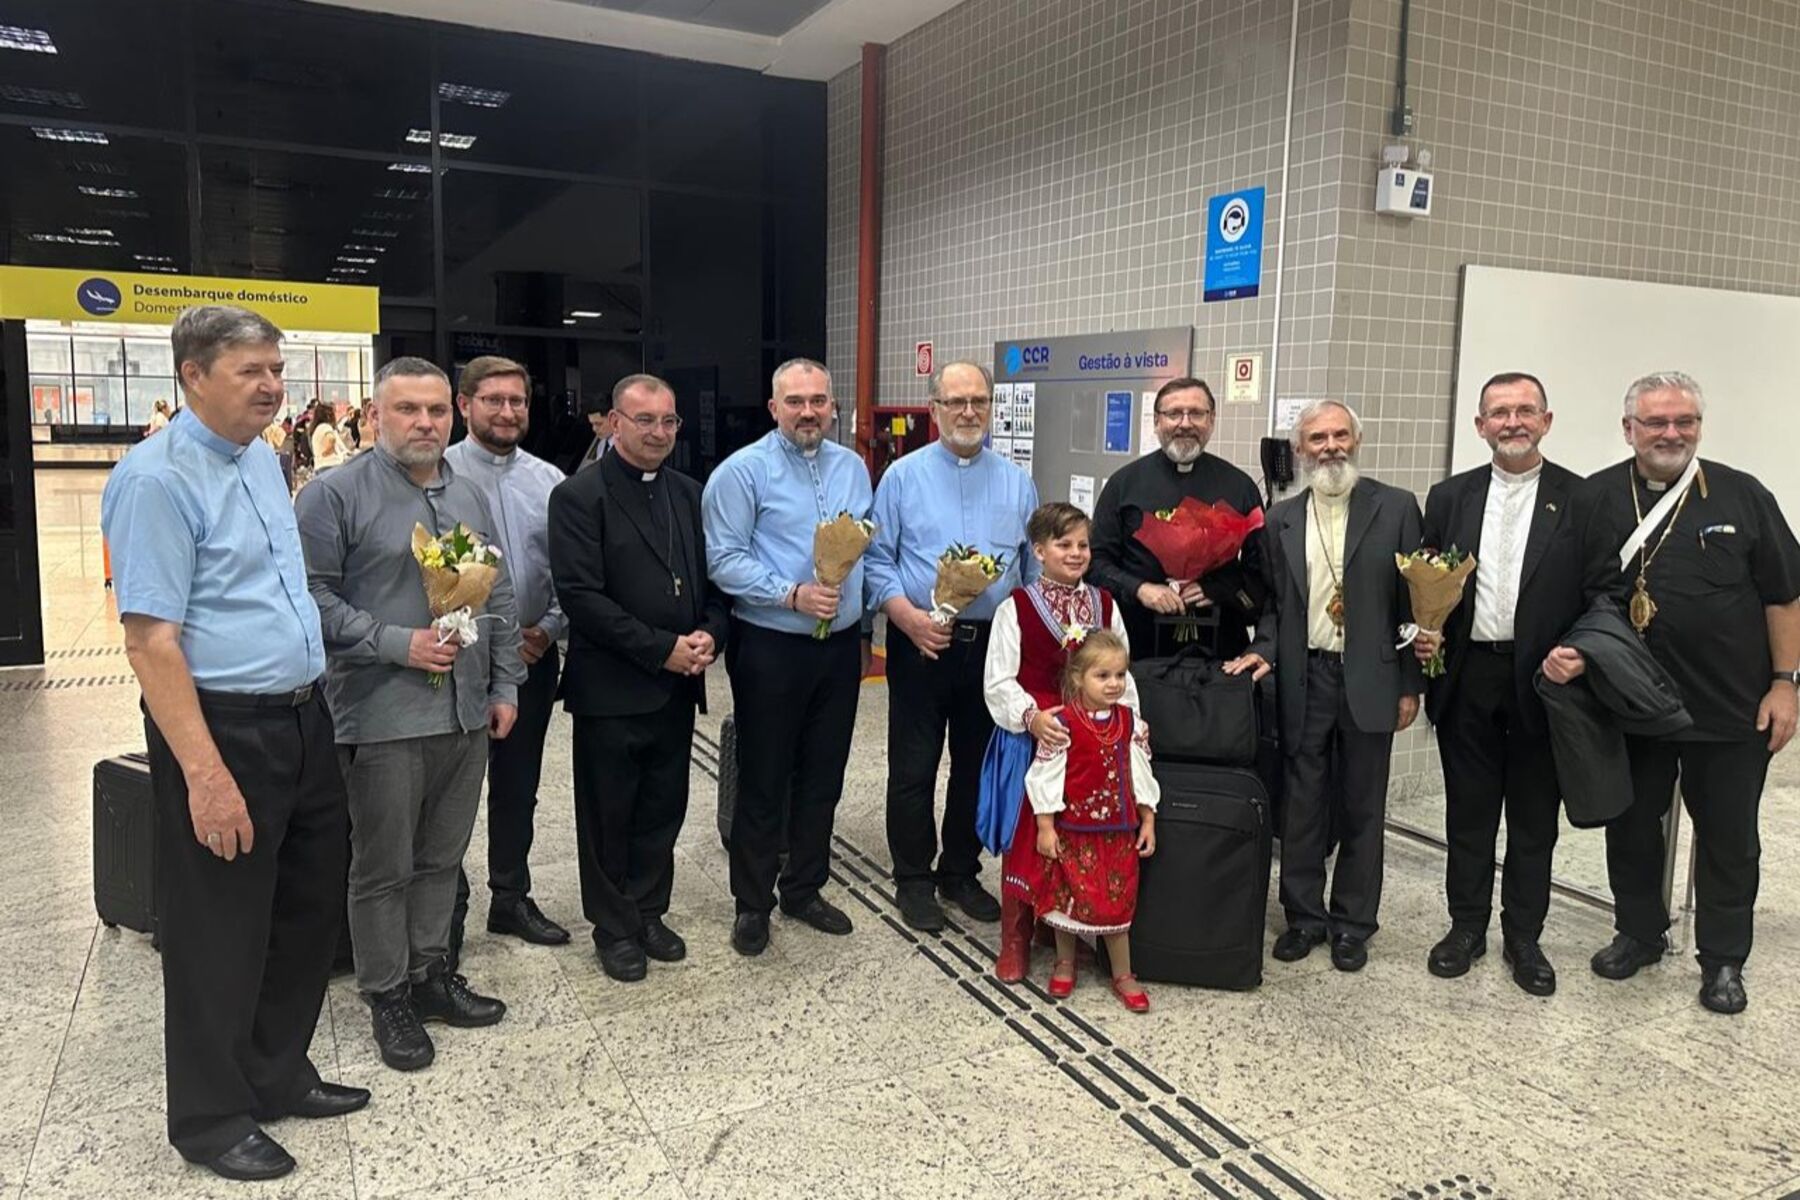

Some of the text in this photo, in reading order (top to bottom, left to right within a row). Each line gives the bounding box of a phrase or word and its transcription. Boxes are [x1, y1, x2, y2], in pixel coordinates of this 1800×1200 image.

[134, 284, 308, 304] Desembarque doméstico
[134, 301, 190, 314] Domes
[1023, 346, 1049, 364] CCR
[1079, 351, 1168, 370] Gestão à vista
